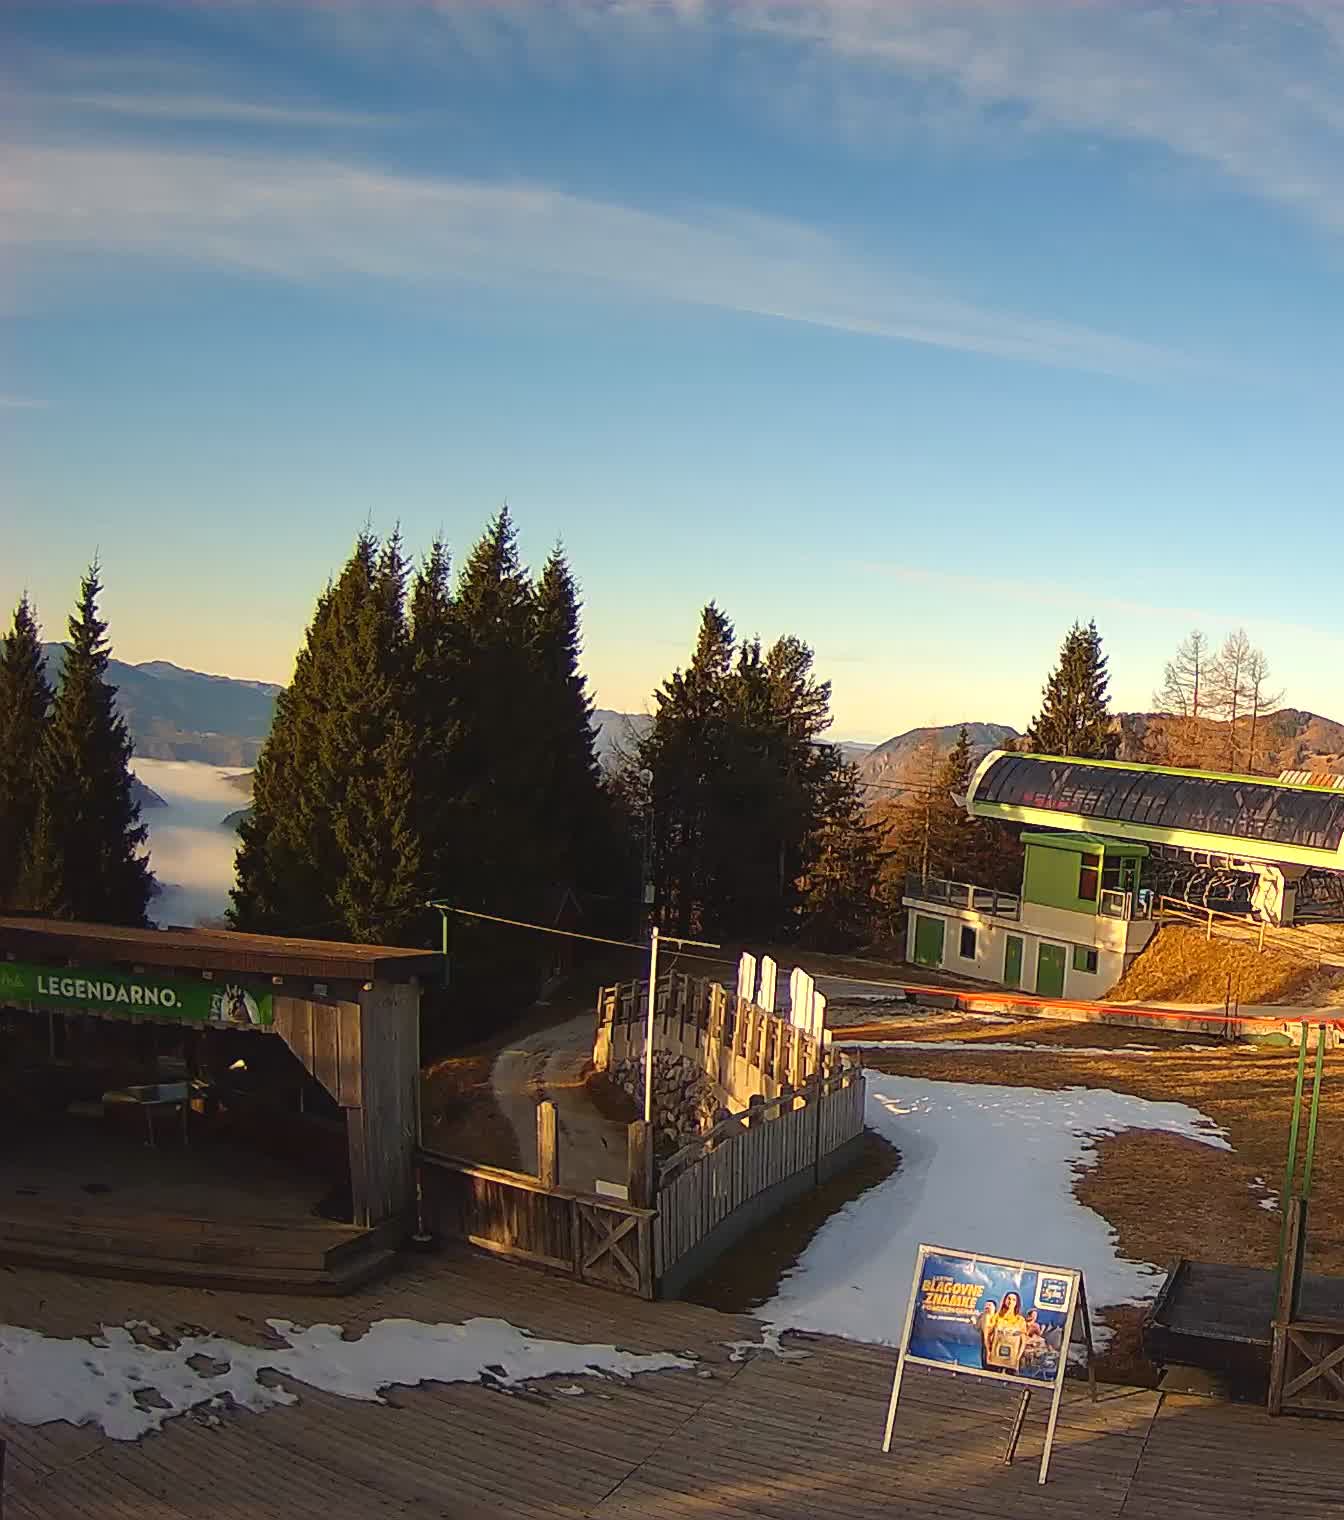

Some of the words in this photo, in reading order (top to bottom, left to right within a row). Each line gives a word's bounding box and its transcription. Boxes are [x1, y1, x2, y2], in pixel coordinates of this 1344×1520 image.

[37, 975, 182, 1008] LEGENDARNO.
[922, 1279, 985, 1298] BLAGOVNE
[923, 1292, 978, 1310] ZNAMKE
